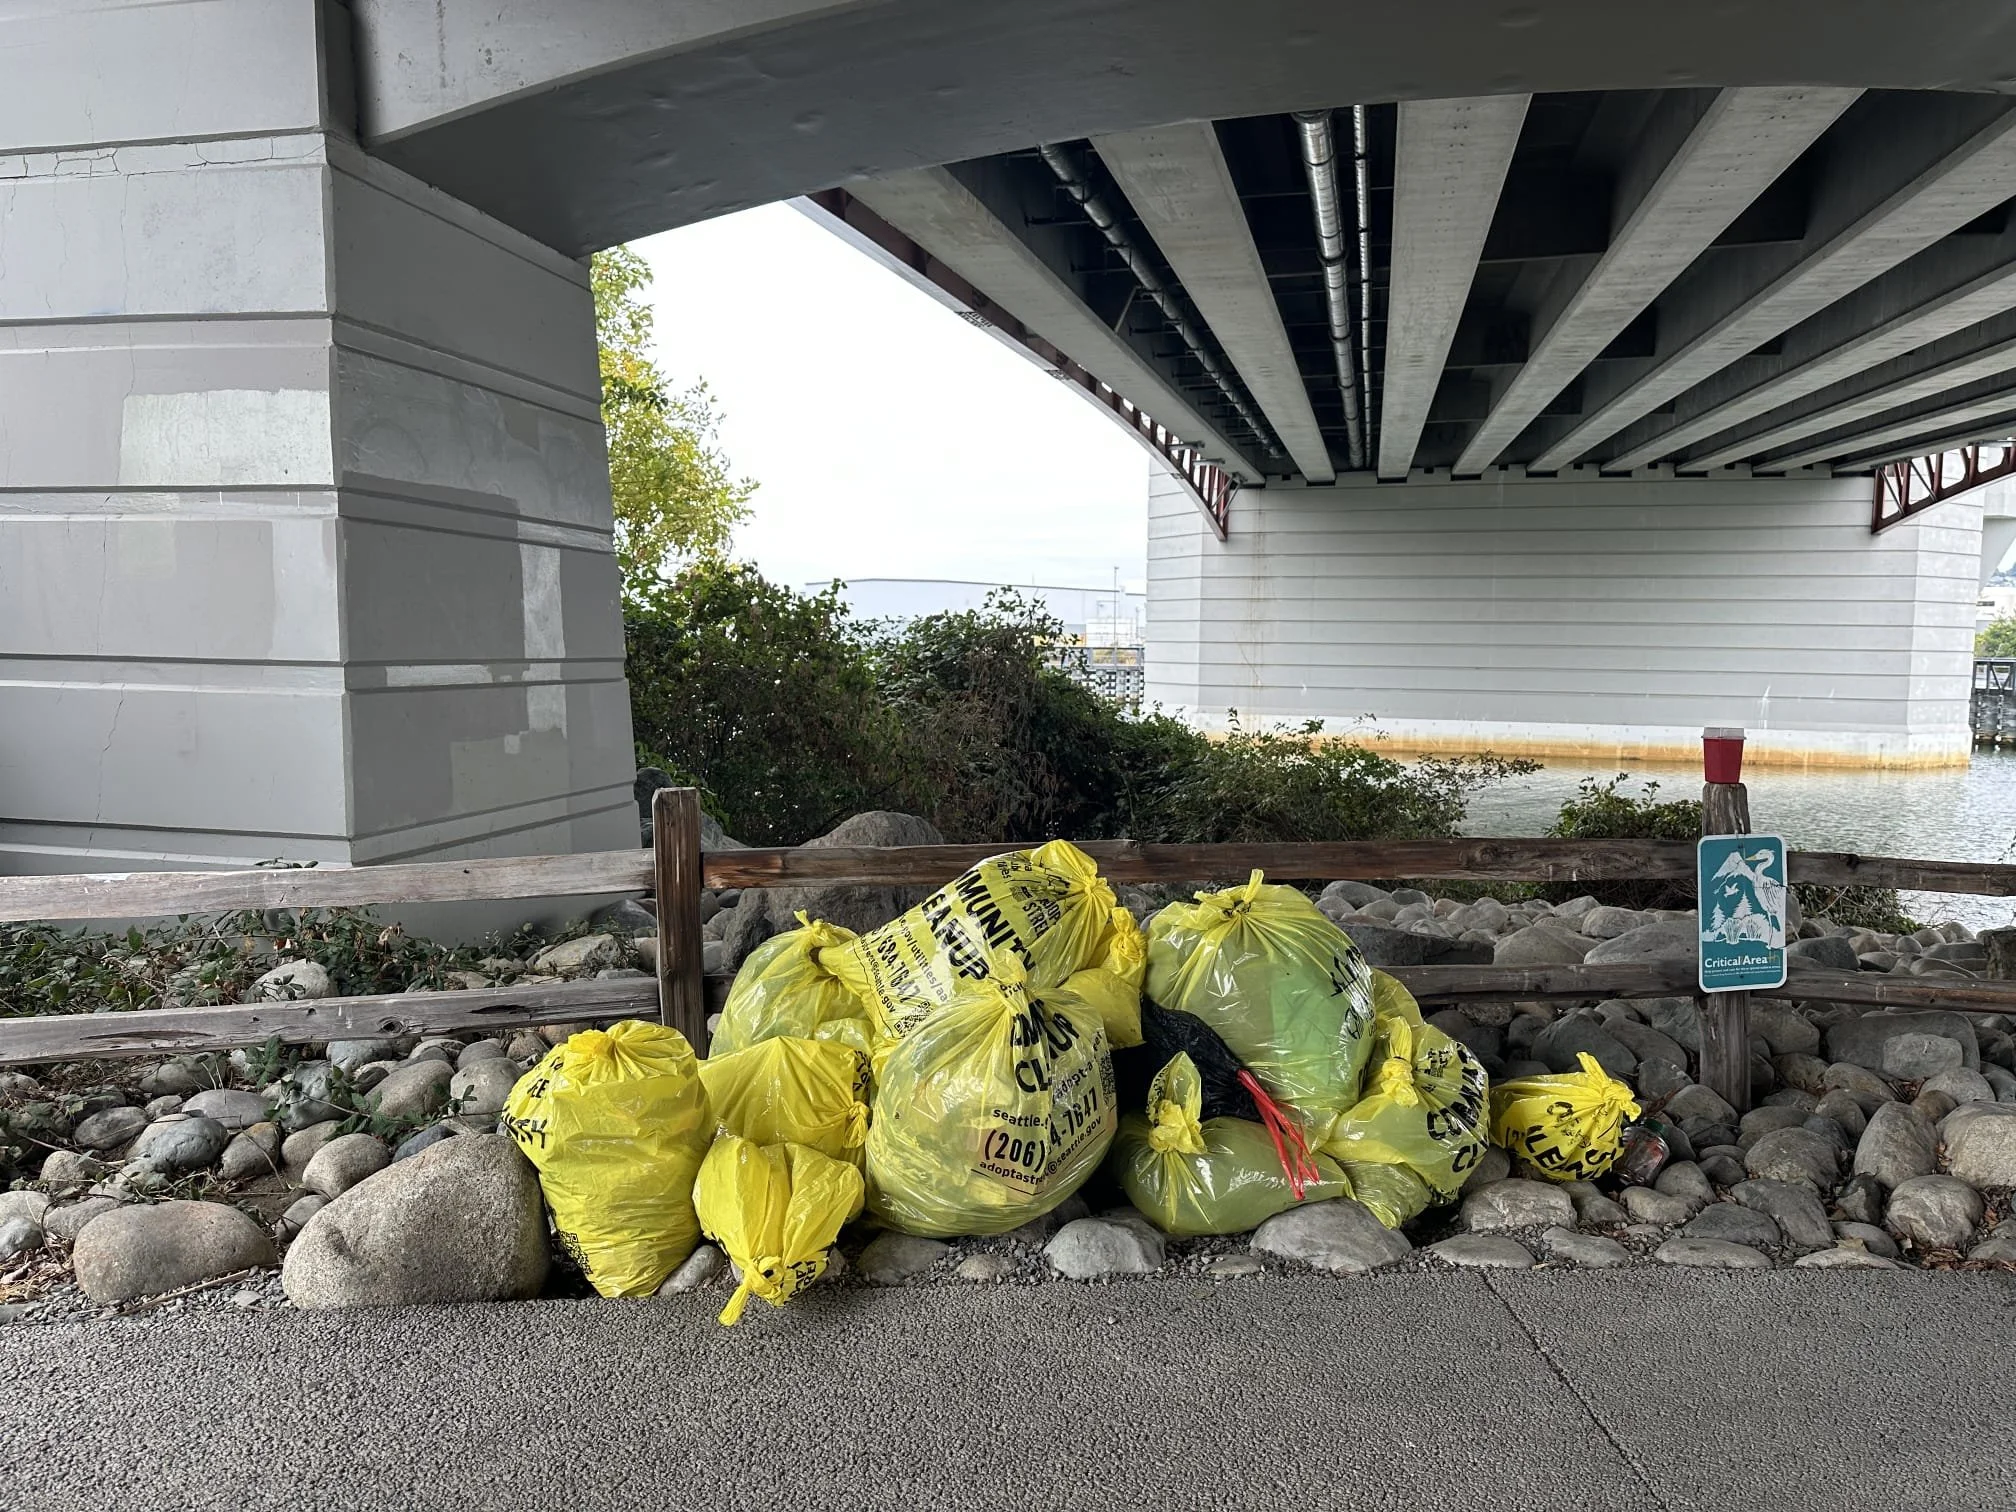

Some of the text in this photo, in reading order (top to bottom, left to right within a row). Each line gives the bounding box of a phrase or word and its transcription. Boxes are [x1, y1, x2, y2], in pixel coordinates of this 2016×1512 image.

[921, 892, 990, 981] EANUP
[1704, 955, 1768, 968] Critical Area
[984, 1129, 1046, 1173] (206)
